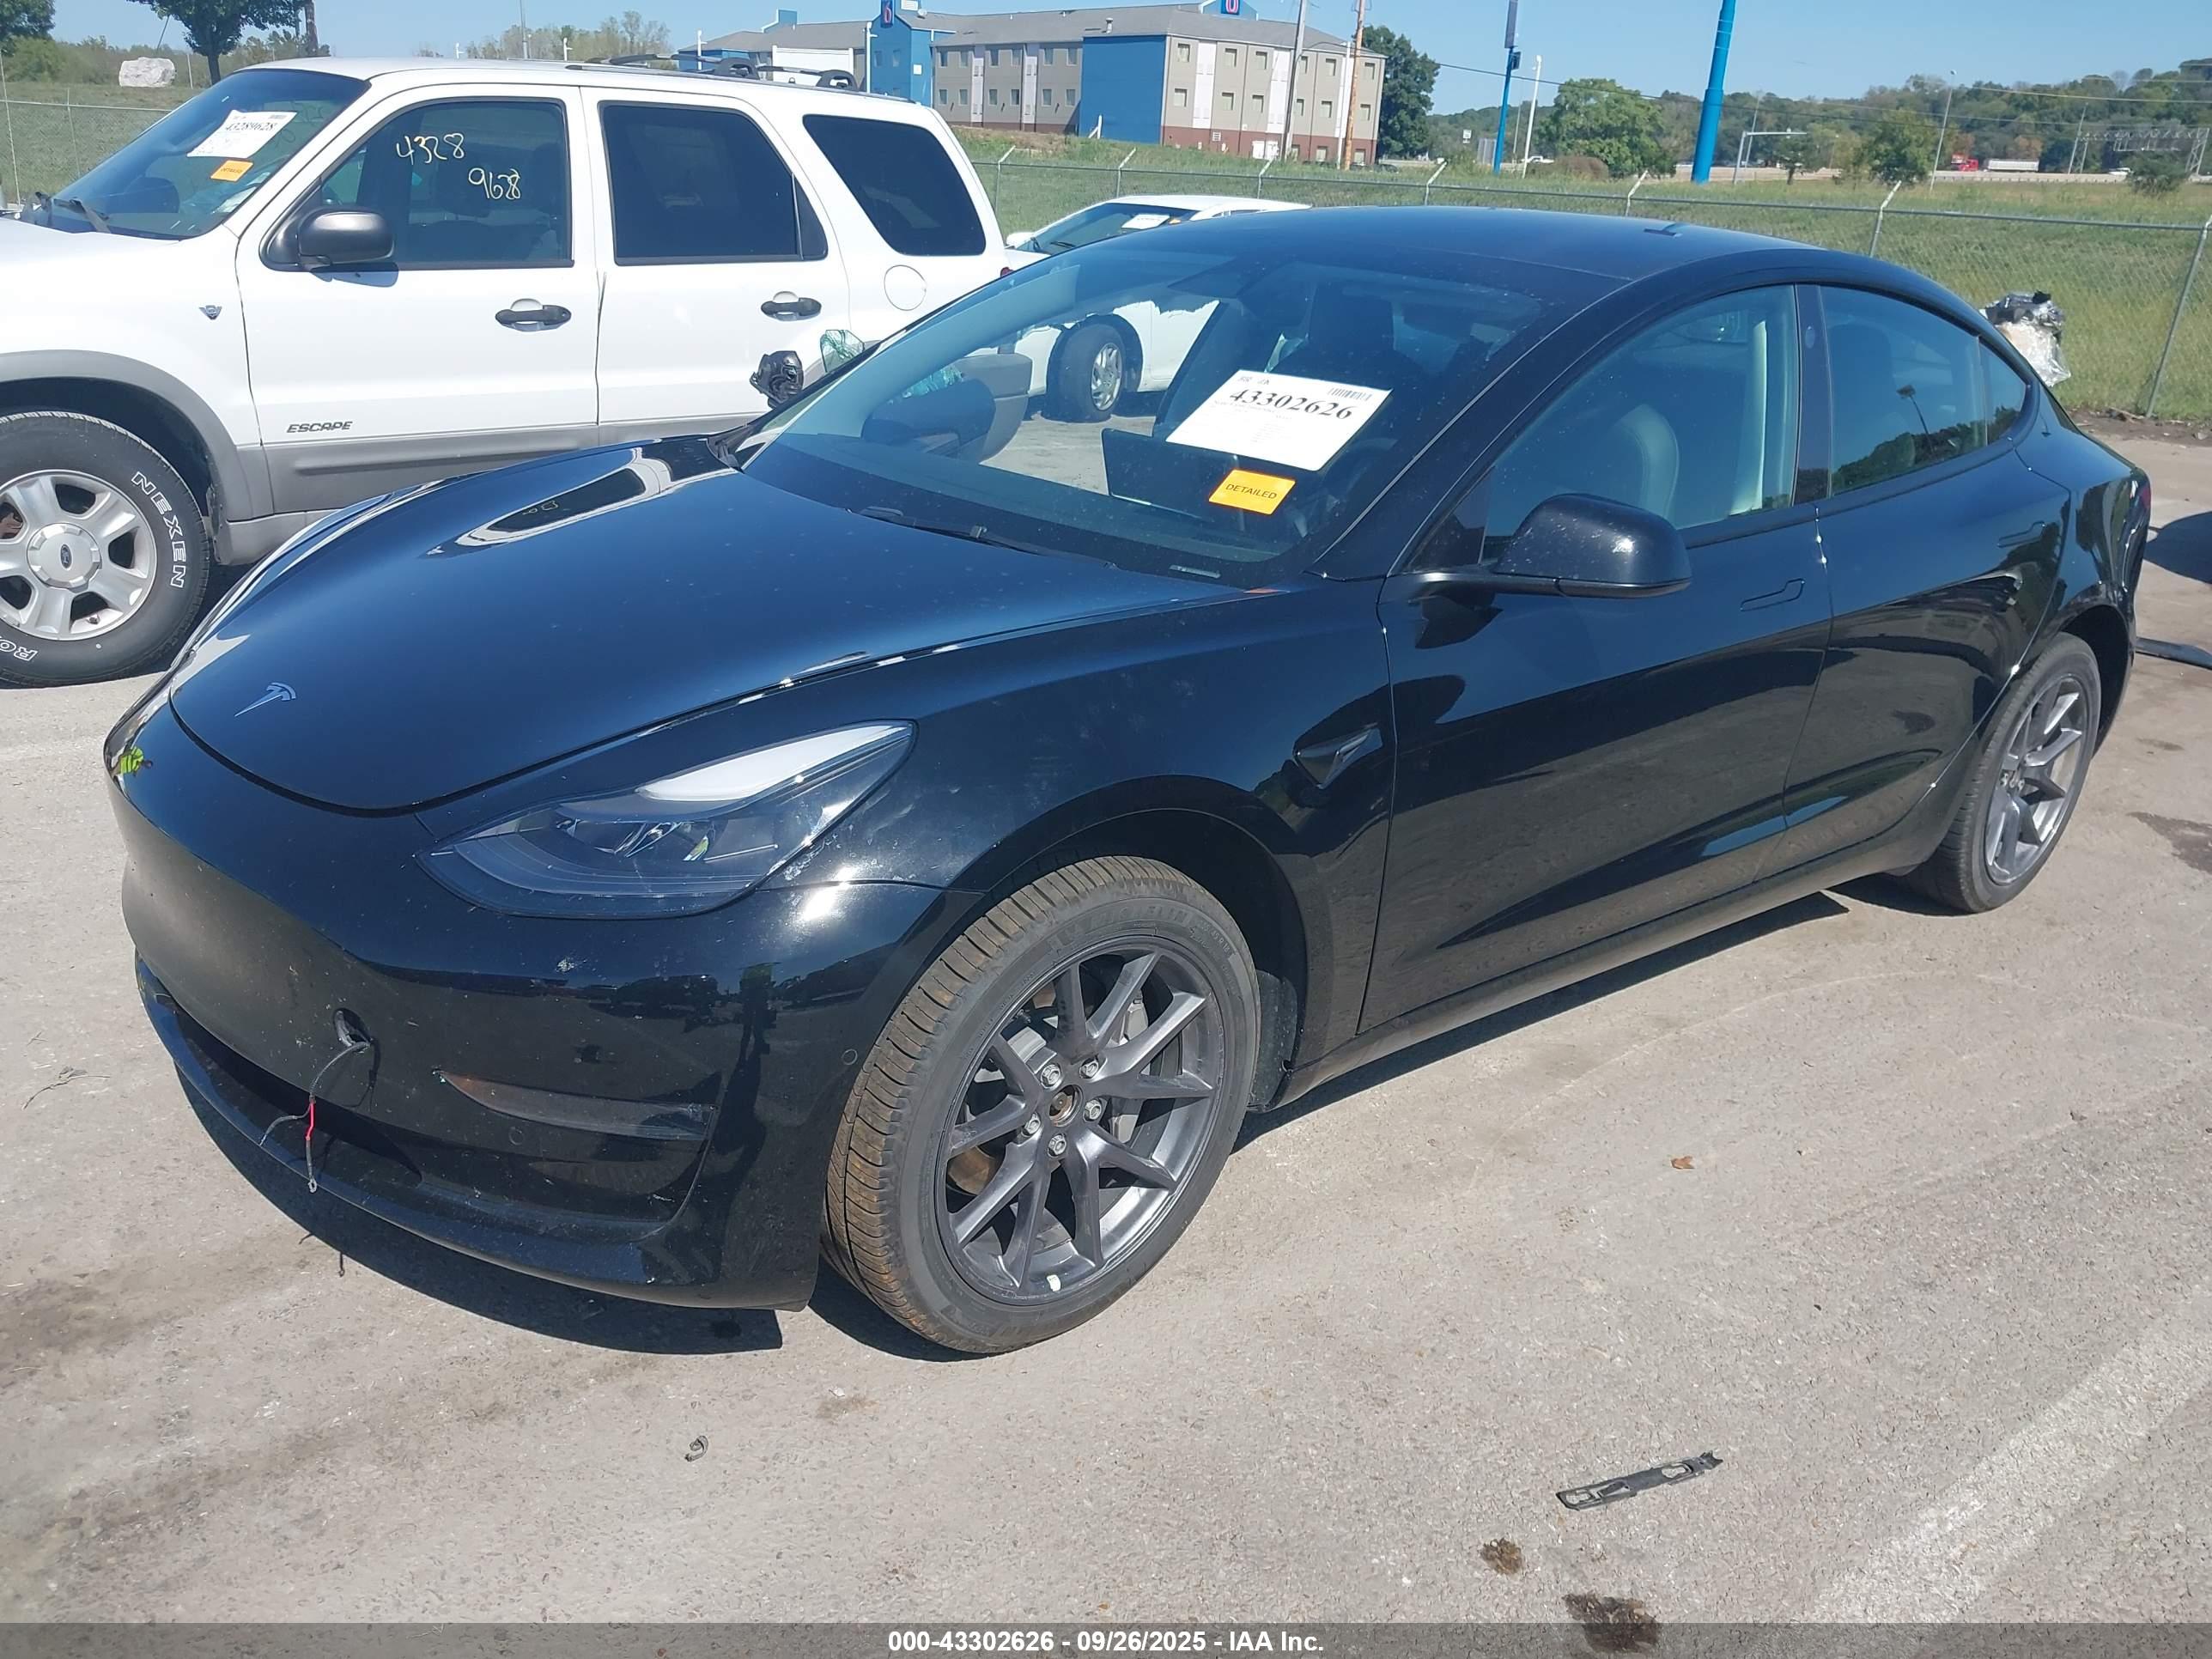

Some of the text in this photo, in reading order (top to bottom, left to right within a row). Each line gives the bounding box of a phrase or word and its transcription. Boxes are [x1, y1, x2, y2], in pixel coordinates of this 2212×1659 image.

[396, 133, 465, 165] 4328
[1230, 389, 1358, 419] 43302626
[286, 421, 353, 433] ESCAPE
[1225, 483, 1278, 499] DETAILED
[131, 471, 186, 587] NEXEN
[0, 637, 39, 661] RO
